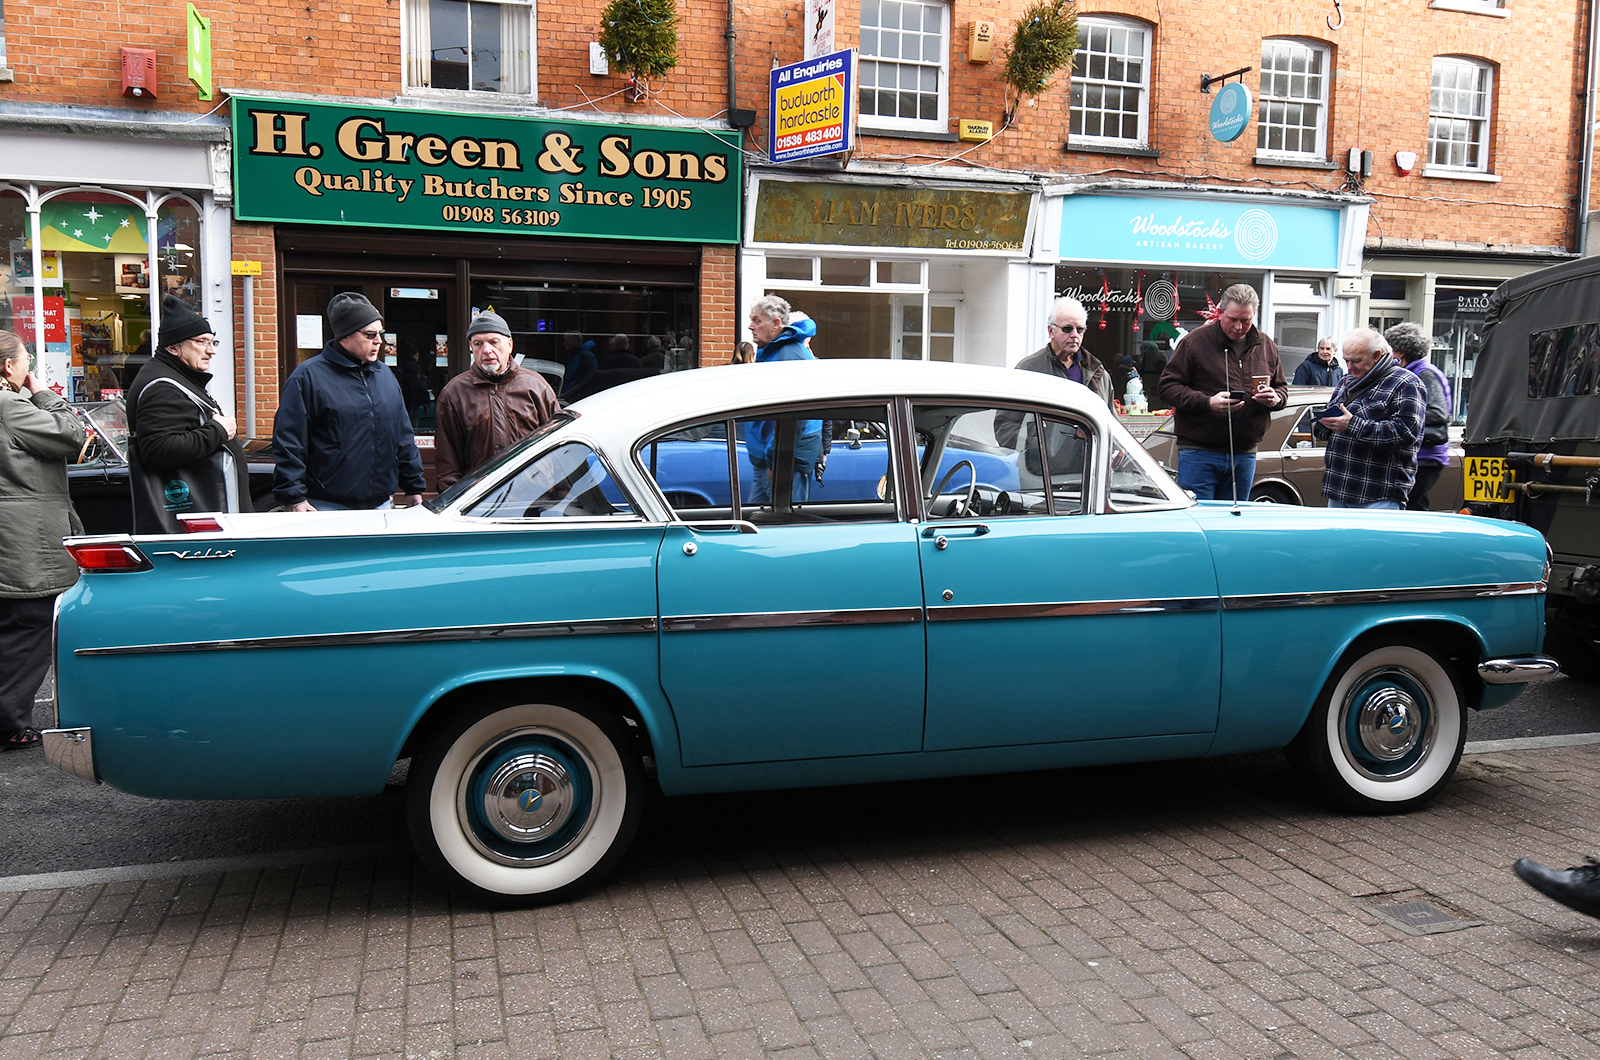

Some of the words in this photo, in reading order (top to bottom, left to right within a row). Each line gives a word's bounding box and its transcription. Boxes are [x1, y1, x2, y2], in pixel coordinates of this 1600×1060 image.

[778, 70, 791, 83] All
[793, 58, 843, 80] Enquiries
[780, 77, 835, 111] budworth
[780, 102, 840, 130] hardcastle
[248, 109, 323, 159] H.
[335, 115, 523, 173] Green
[535, 129, 587, 175] &
[598, 133, 729, 184] Sons
[777, 133, 803, 149] 01536
[805, 130, 823, 143] 483
[823, 125, 841, 140] 400
[775, 142, 843, 160] www.budworthhardcastle.com
[294, 166, 414, 202] Quality
[421, 174, 551, 202] Butchers
[558, 181, 635, 207] Since
[641, 187, 692, 210] 1905
[442, 205, 495, 223] 01908
[500, 208, 561, 227] 563109
[811, 198, 881, 226] LIAM
[893, 202, 977, 230] IVERS
[1129, 213, 1231, 239] Woodstock's
[1136, 240, 1180, 248] ARTISAN
[1458, 296, 1490, 308] BARO
[152, 547, 237, 560] Velox
